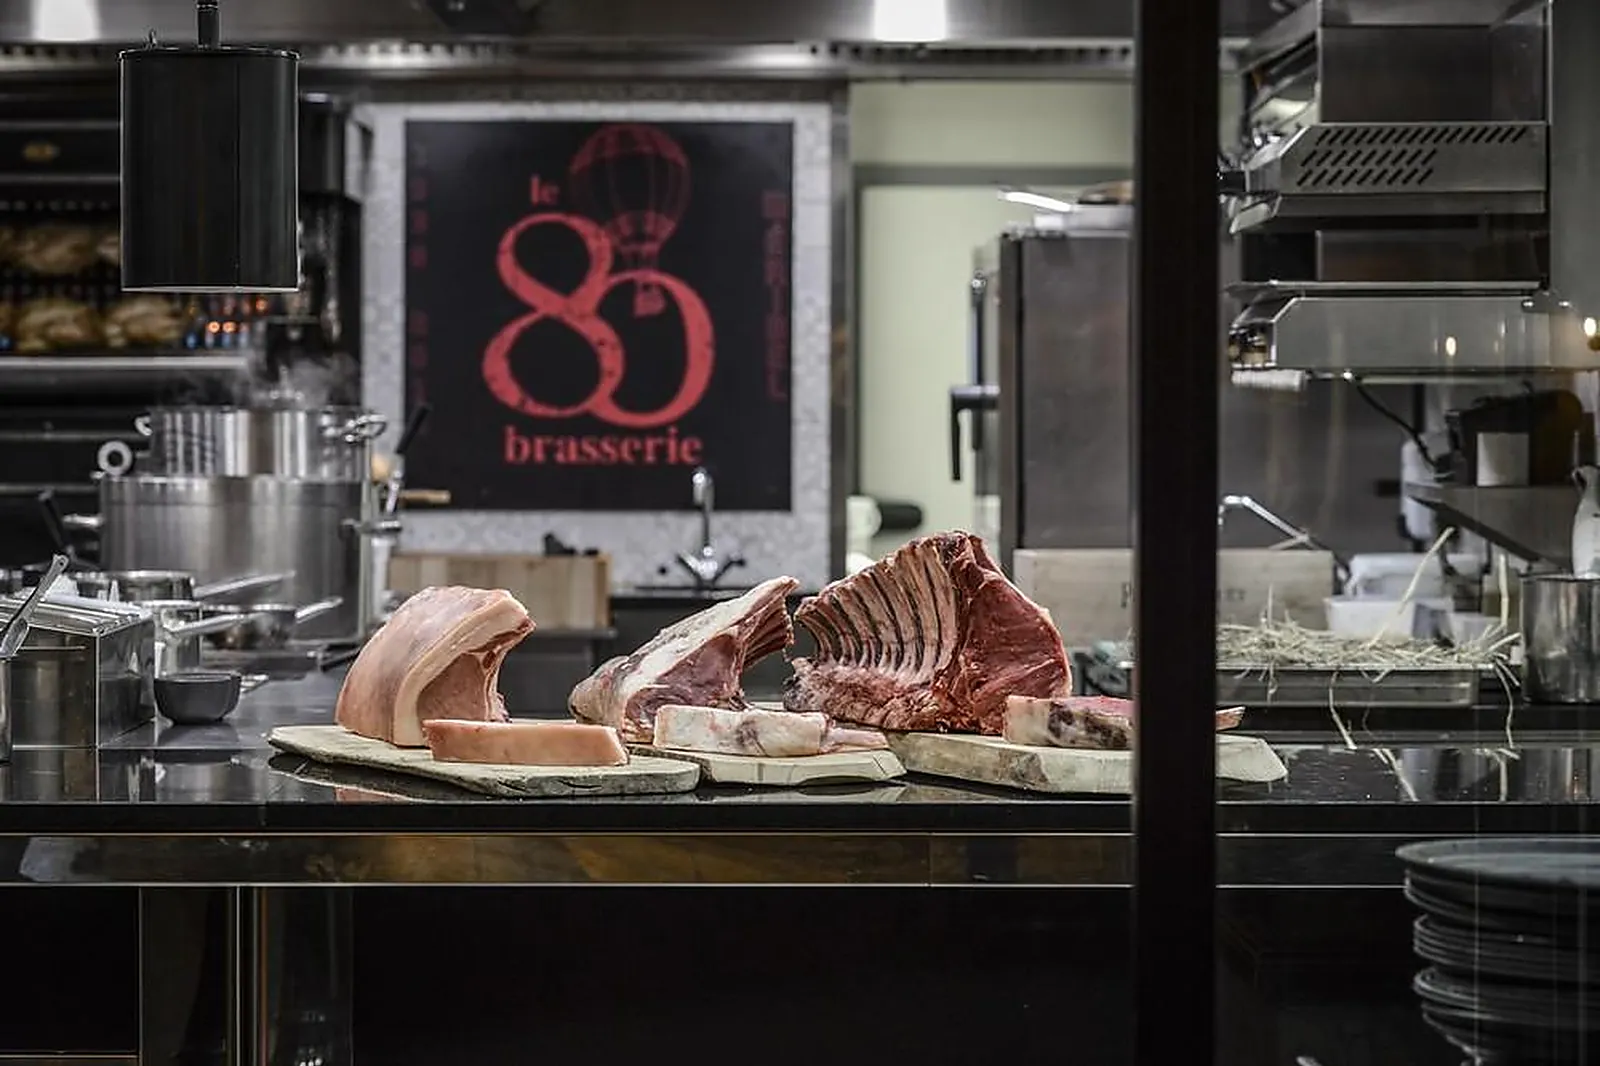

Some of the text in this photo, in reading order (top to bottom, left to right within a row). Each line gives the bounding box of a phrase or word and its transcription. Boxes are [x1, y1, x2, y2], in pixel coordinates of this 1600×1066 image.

[530, 175, 559, 205] le
[482, 212, 715, 428] 80
[504, 425, 704, 465] brasserie
